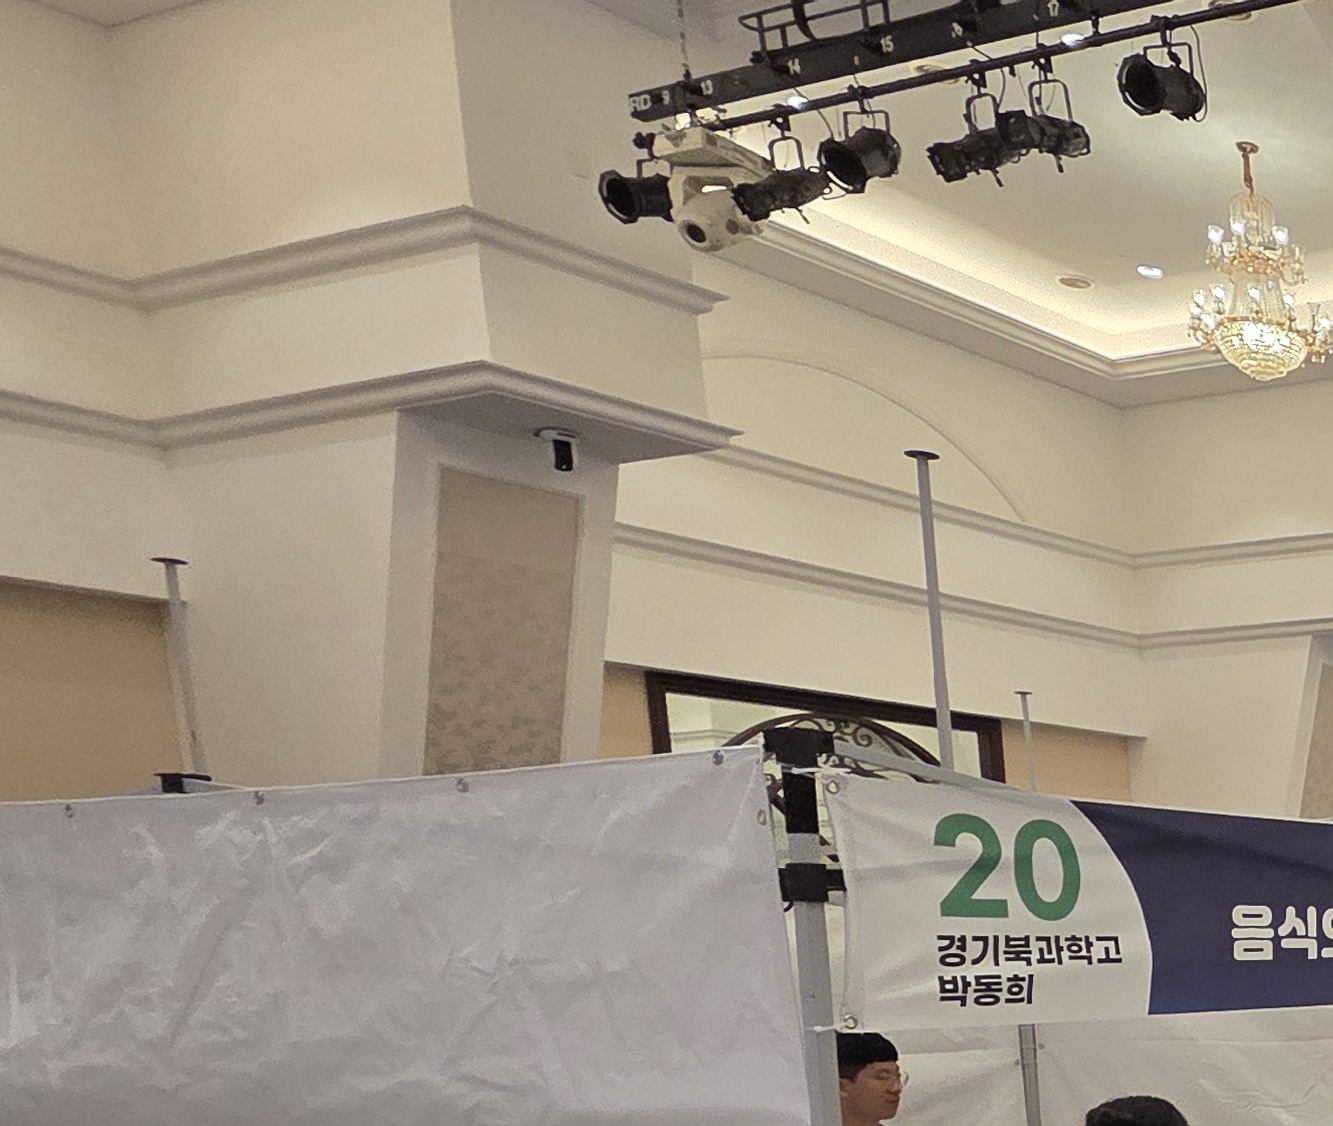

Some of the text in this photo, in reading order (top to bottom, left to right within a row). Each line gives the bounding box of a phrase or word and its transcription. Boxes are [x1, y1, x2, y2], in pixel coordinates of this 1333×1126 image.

[934, 813, 1081, 921] 20
[937, 935, 1123, 967] 경기북과학고
[938, 974, 1034, 1007] 박동희
